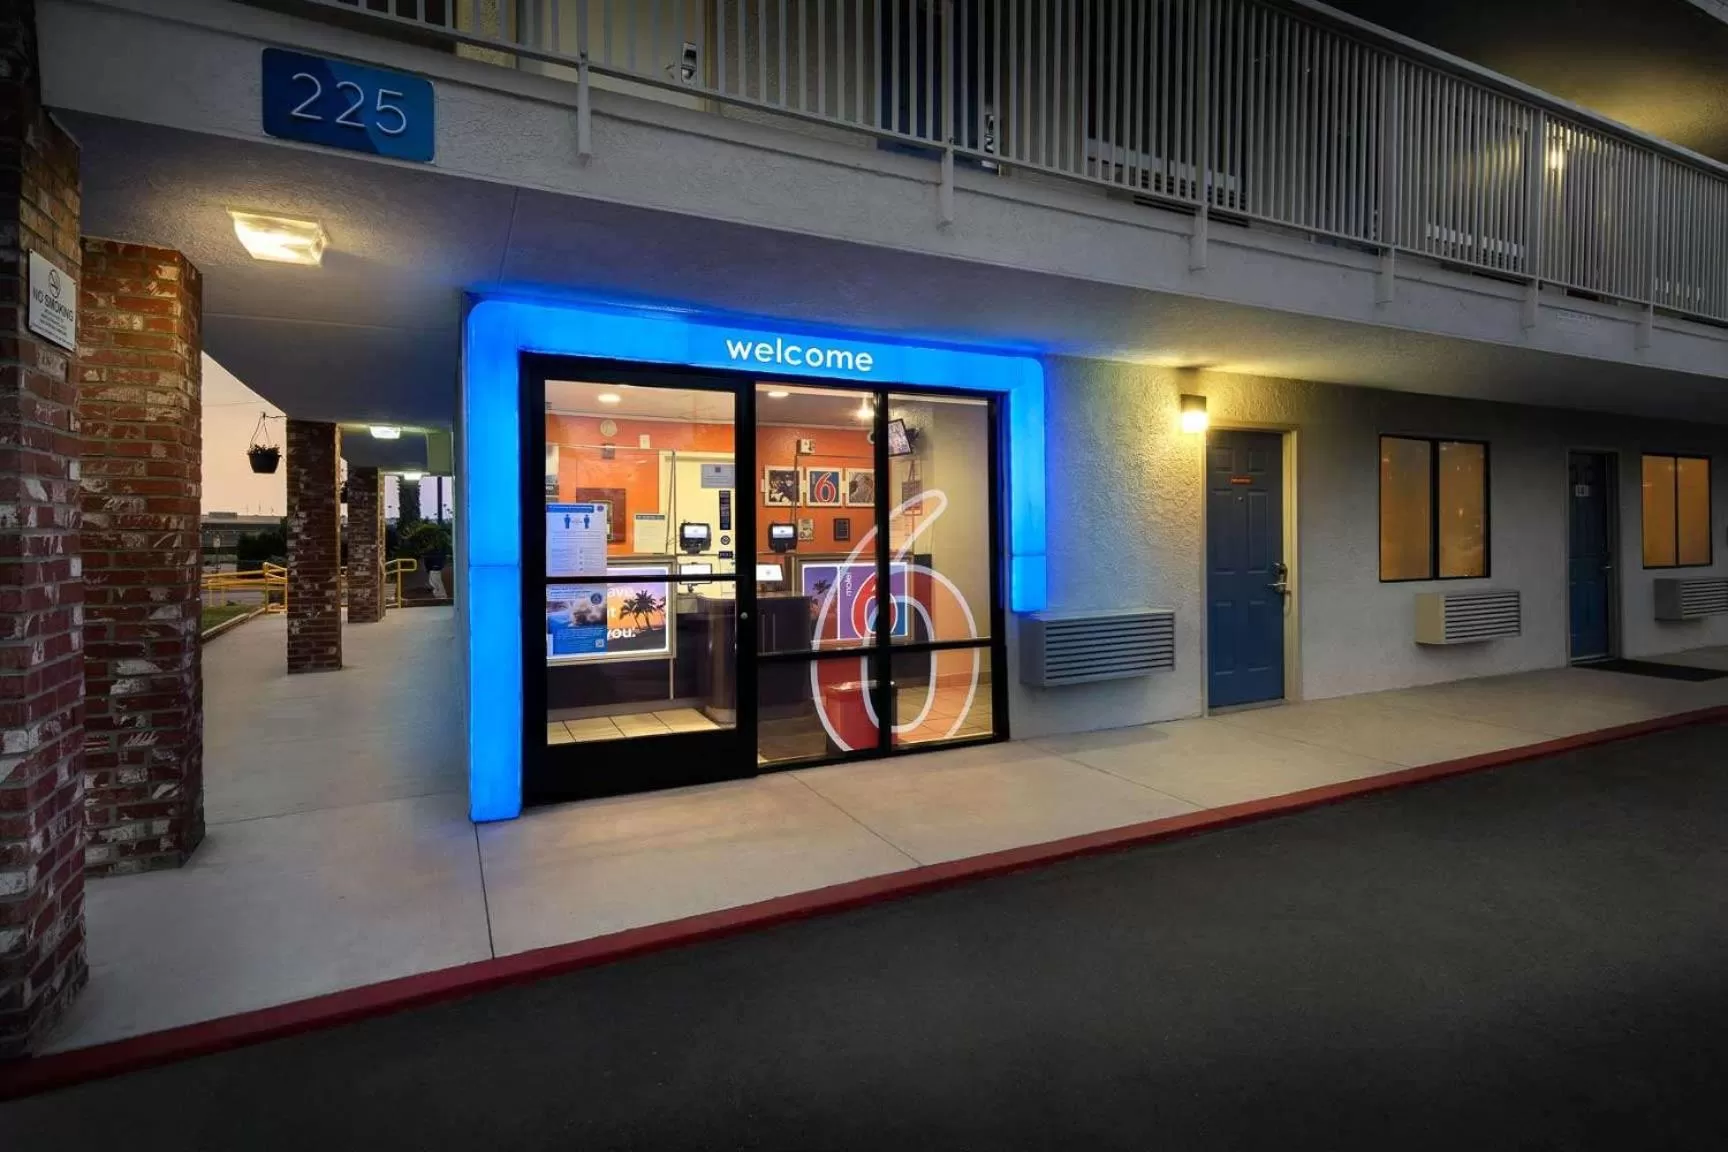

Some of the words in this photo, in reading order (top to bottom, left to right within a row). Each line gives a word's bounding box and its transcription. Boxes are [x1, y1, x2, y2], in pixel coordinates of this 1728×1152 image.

[291, 73, 407, 134] 225
[33, 287, 44, 303] NO
[44, 294, 74, 322] SMOKING
[726, 338, 874, 371] welcome
